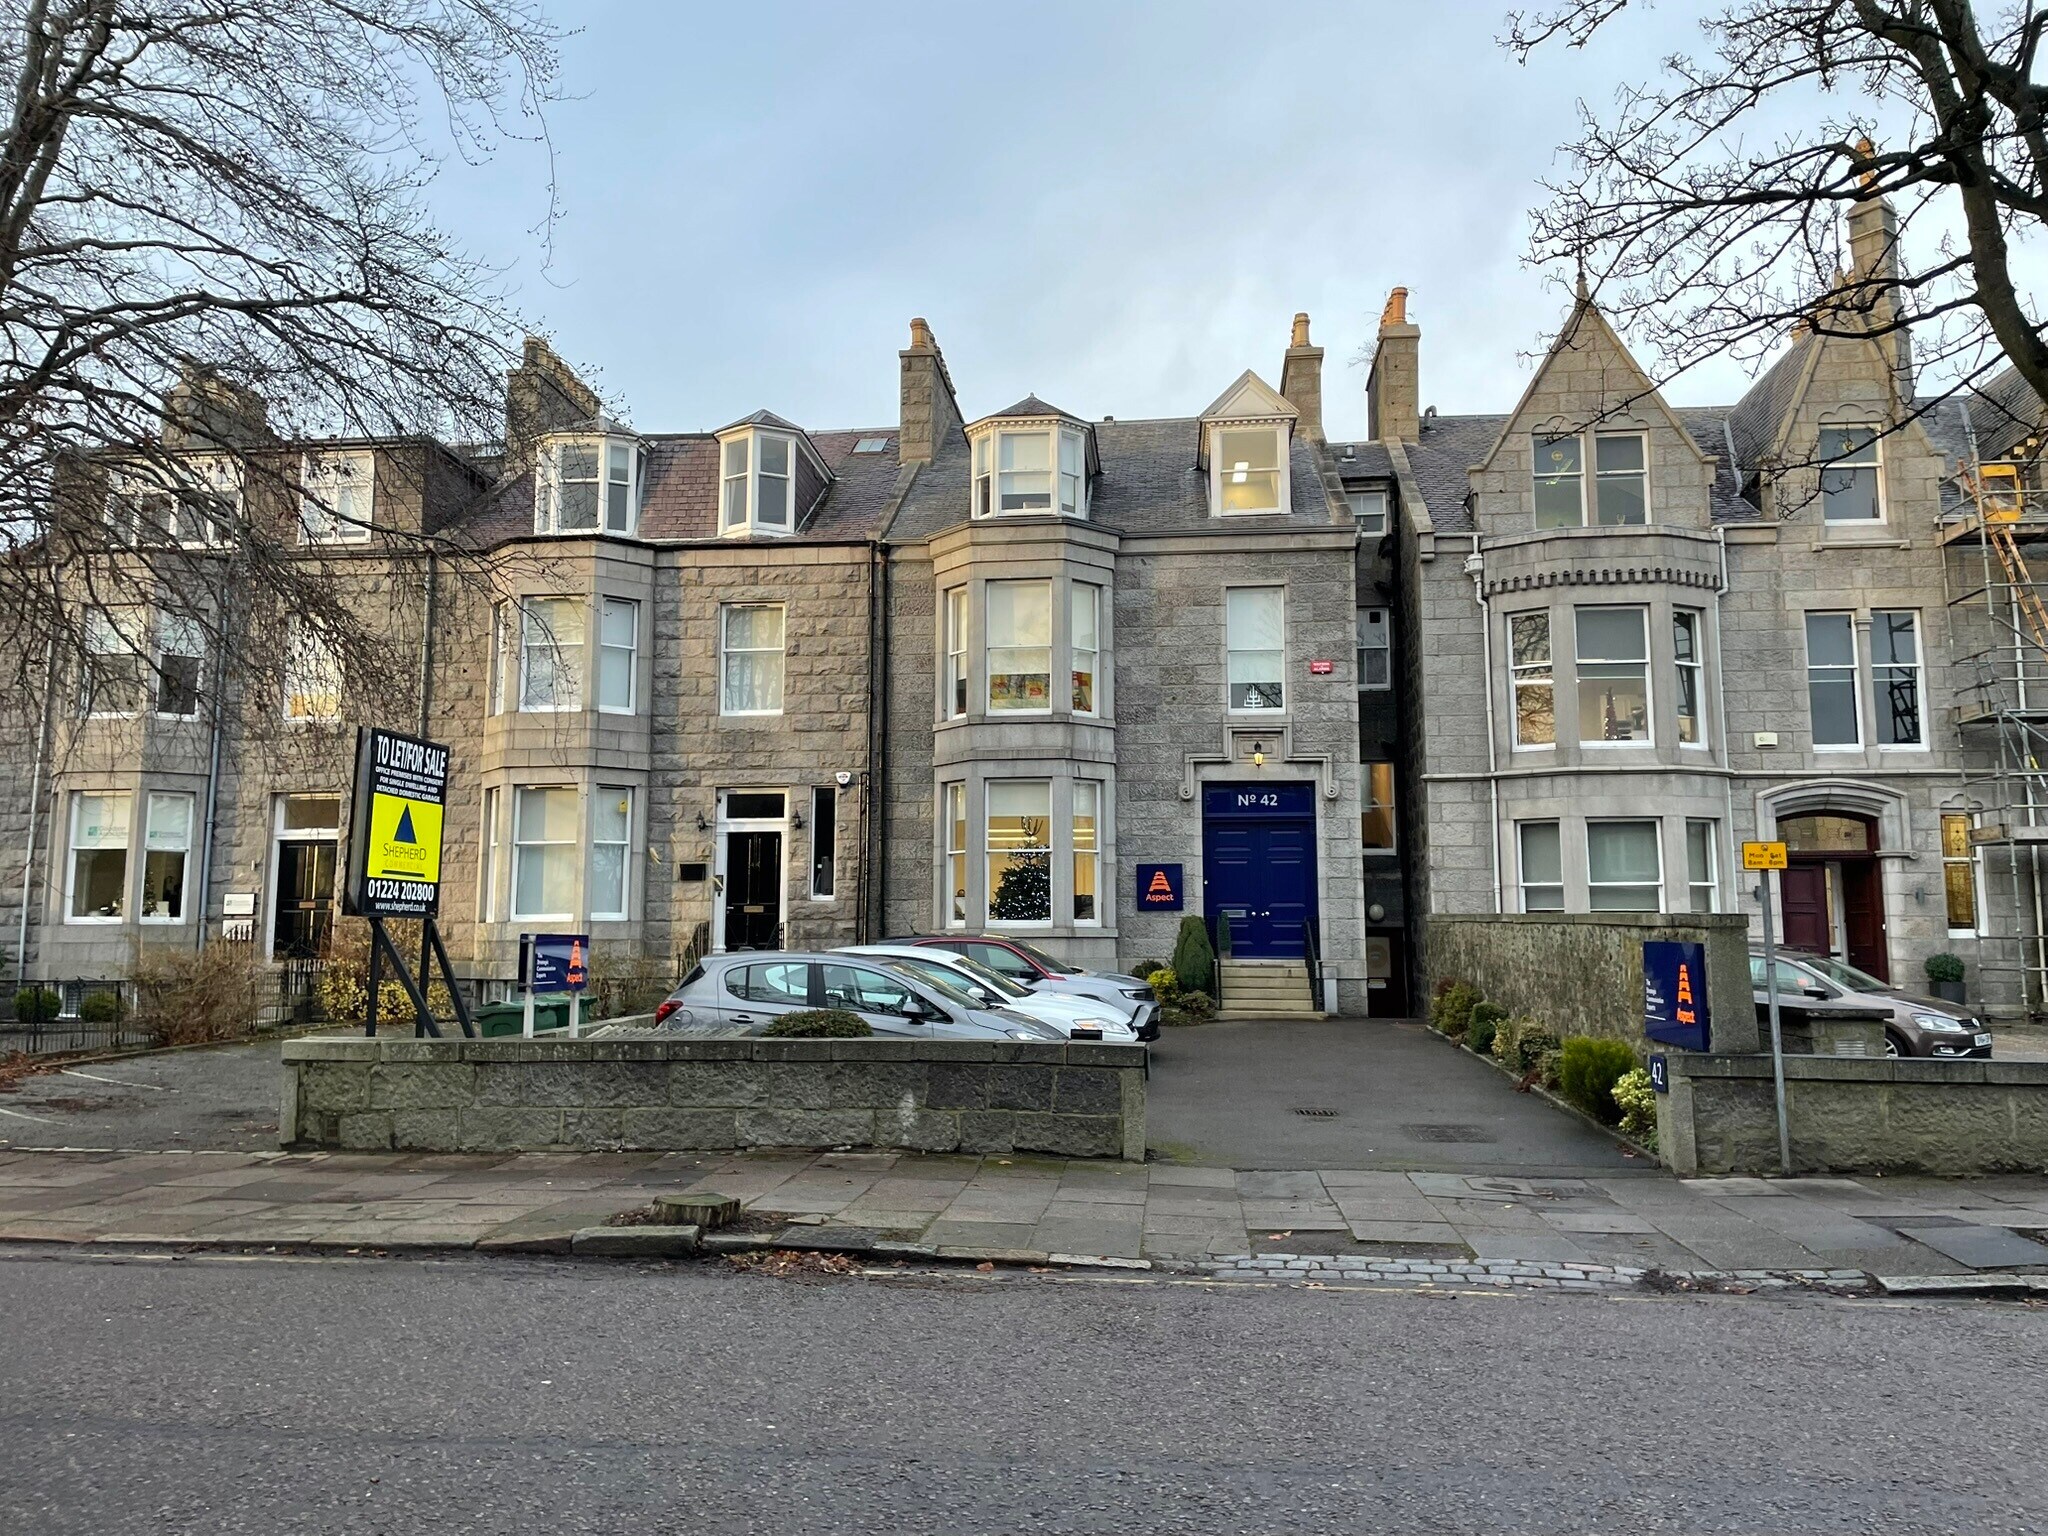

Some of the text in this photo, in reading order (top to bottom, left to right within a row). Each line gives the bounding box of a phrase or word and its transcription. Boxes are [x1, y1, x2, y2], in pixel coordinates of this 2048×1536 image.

[377, 735, 447, 778] TO LET/FOR SALE
[375, 766, 391, 775] OFFICE
[391, 769, 412, 780] PREMISES
[423, 777, 443, 786] CONSENT
[389, 777, 405, 787] SINGLE
[376, 784, 440, 802] DETACHED DOMESTIC GARAGE
[1260, 794, 1278, 806] 42
[383, 843, 426, 861] SHEPHERD
[368, 879, 434, 901] 01224 202800
[1146, 893, 1175, 903] Aspect
[375, 901, 427, 913] www.shepherd.co.uk
[567, 972, 583, 984] Aspect
[1676, 1007, 1696, 1025] Aspect
[1651, 1062, 1663, 1085] 42
